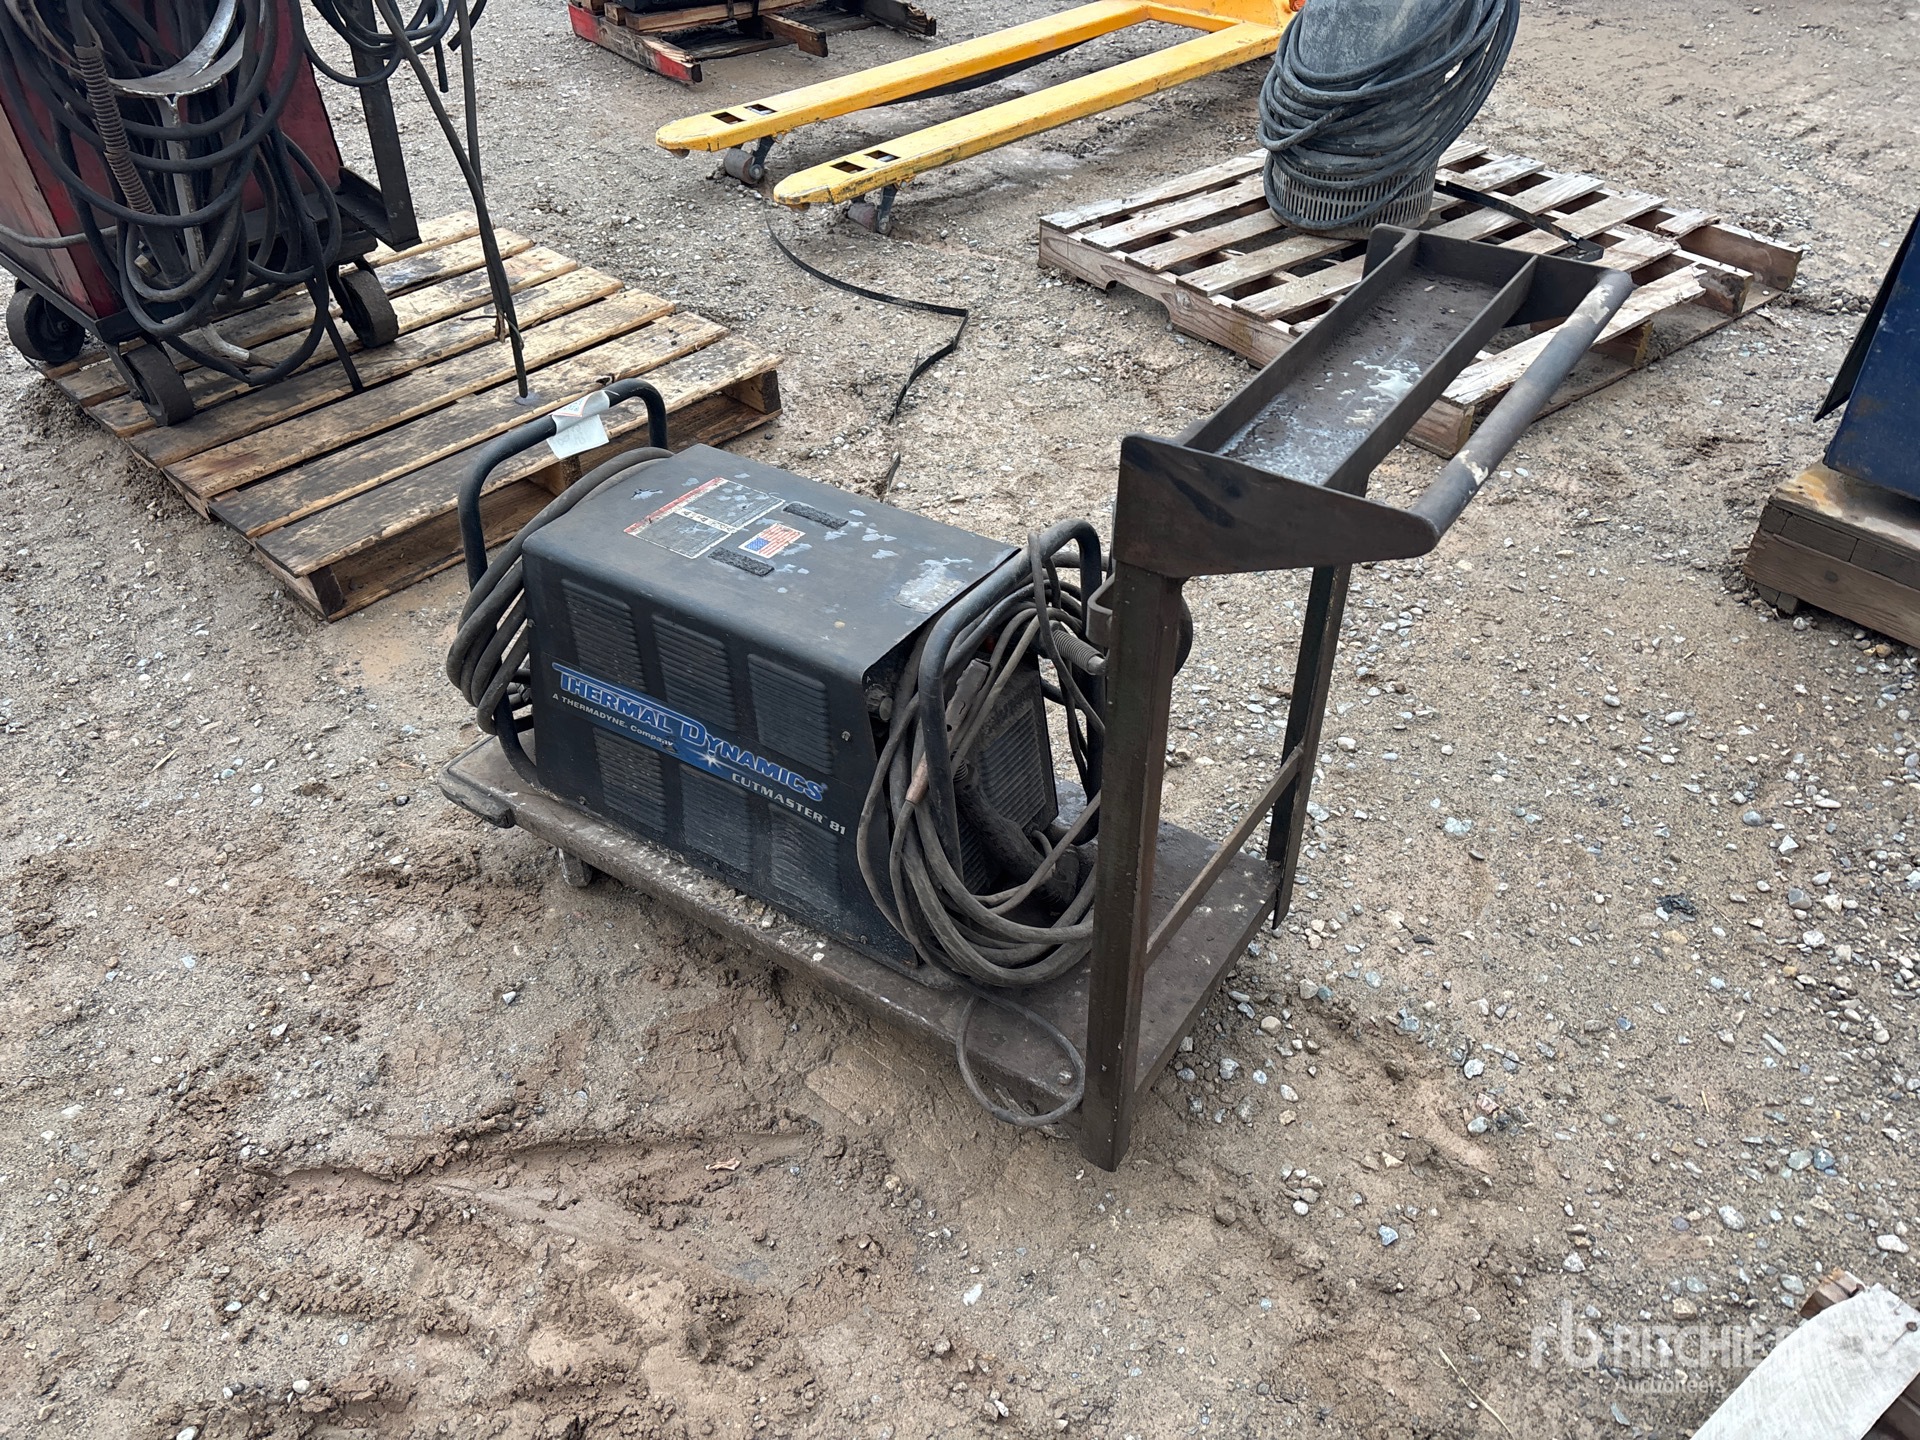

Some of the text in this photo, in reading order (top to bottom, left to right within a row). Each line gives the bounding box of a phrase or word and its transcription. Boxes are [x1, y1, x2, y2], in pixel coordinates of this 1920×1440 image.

[553, 663, 823, 802] THERMAL DYNAMICS
[731, 772, 846, 836] CUTMASTER 81
